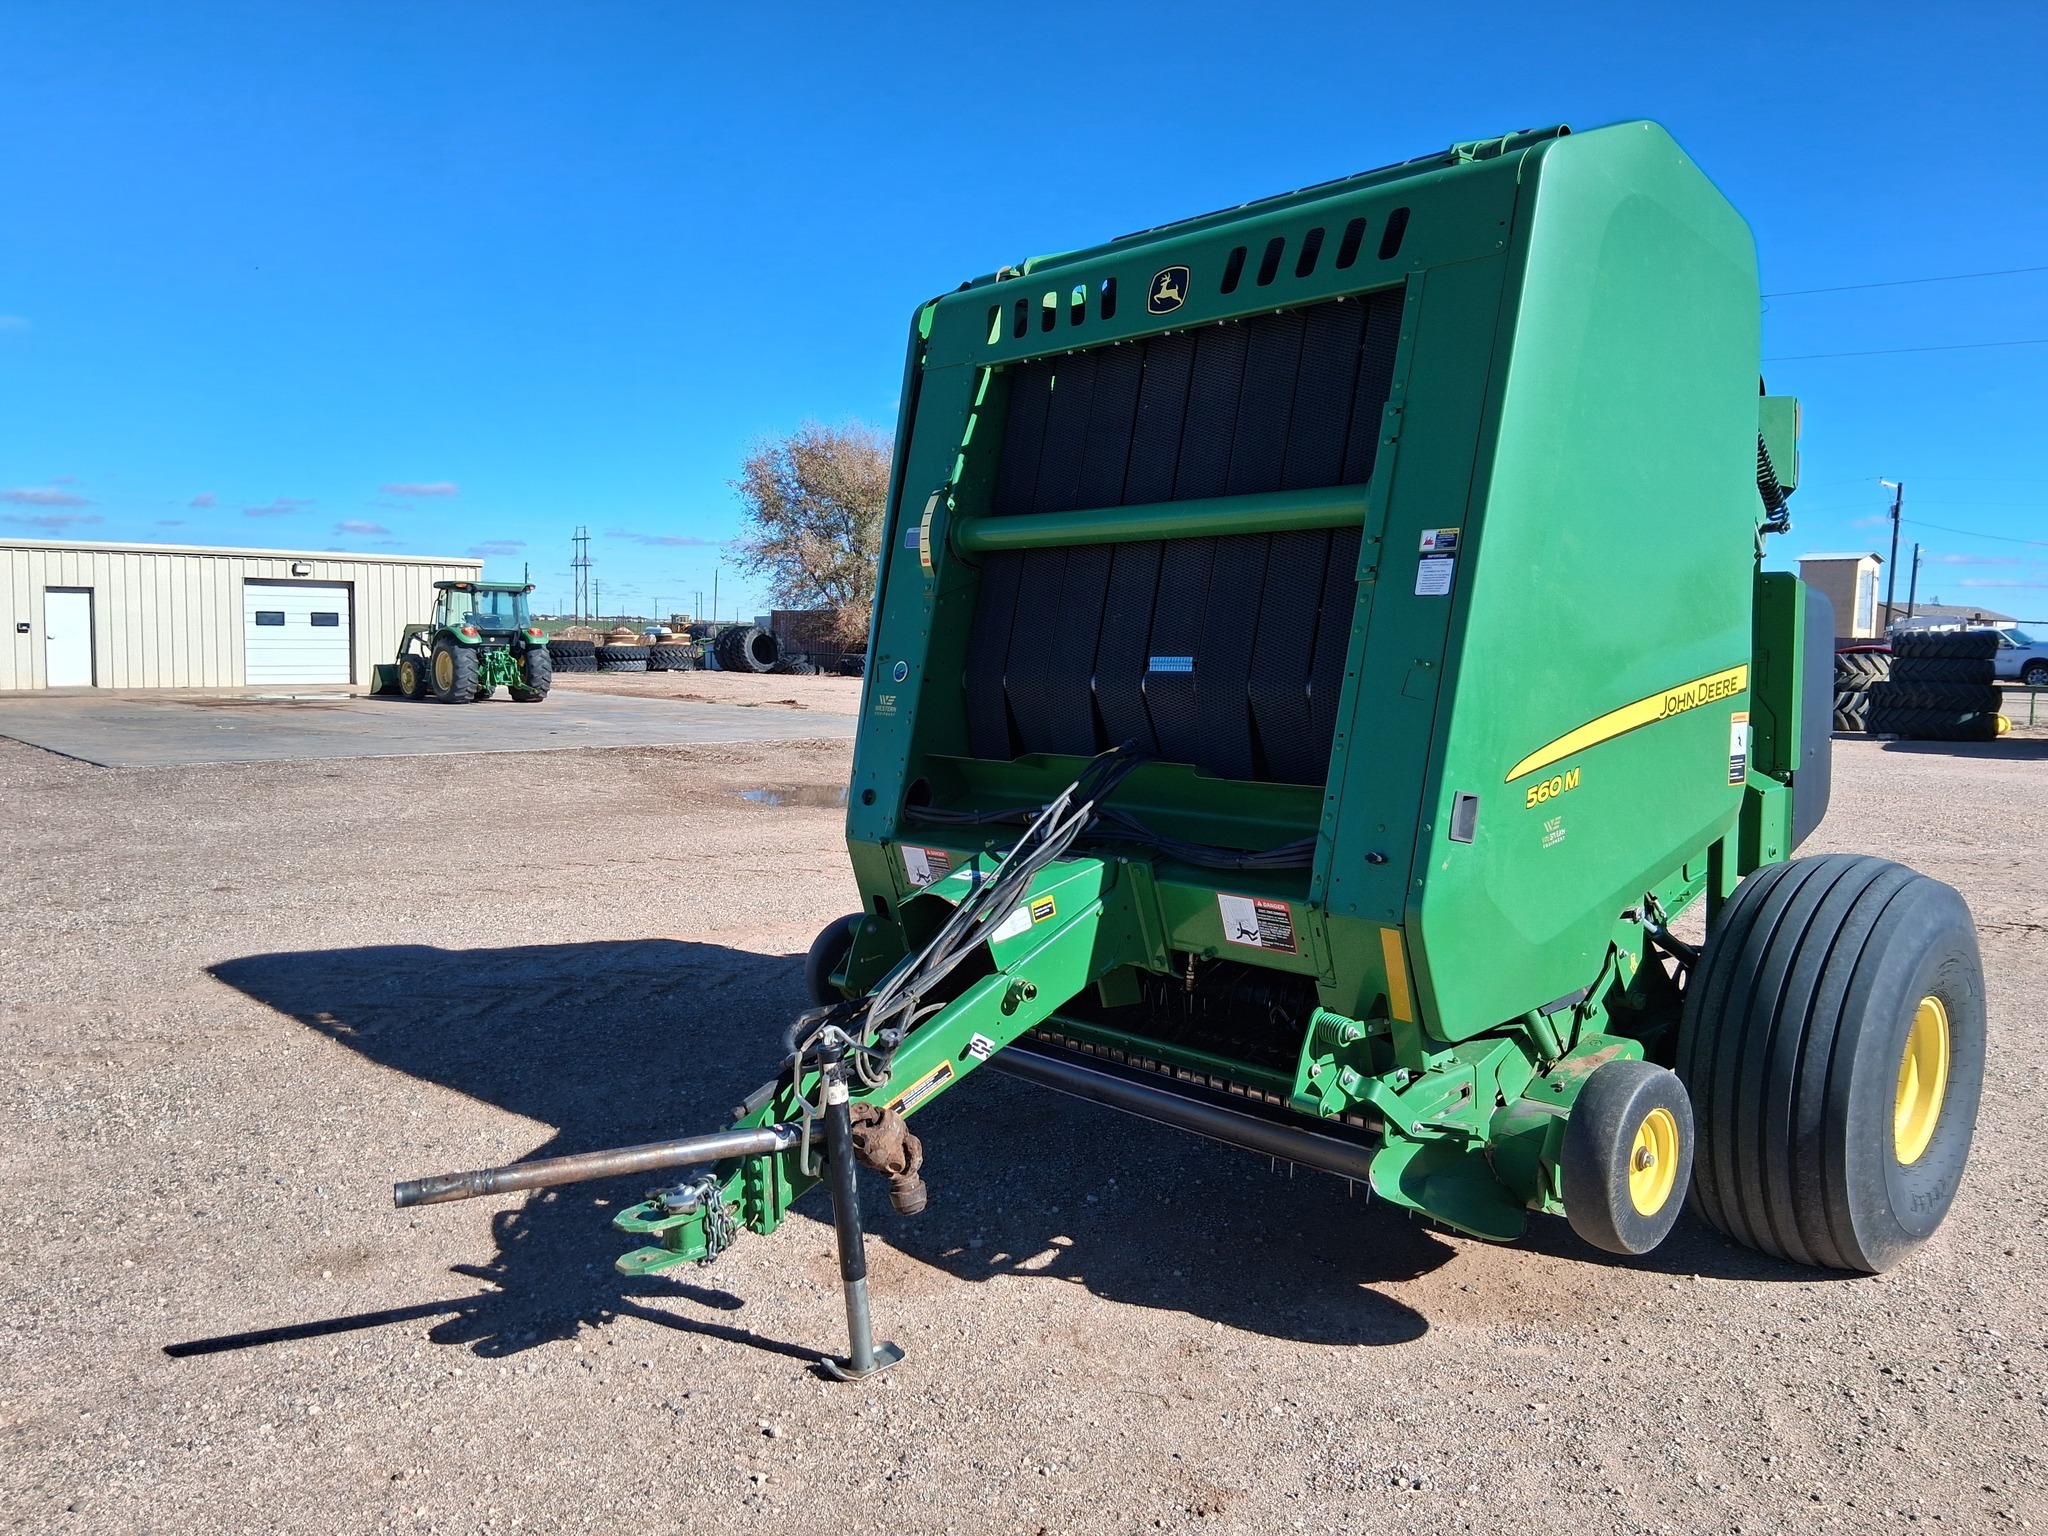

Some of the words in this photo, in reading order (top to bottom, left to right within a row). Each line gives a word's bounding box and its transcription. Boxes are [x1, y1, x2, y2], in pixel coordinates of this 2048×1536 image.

[1660, 690, 1695, 716] JOHN
[1698, 676, 1738, 702] DEERE
[1262, 901, 1286, 911] DANGER
